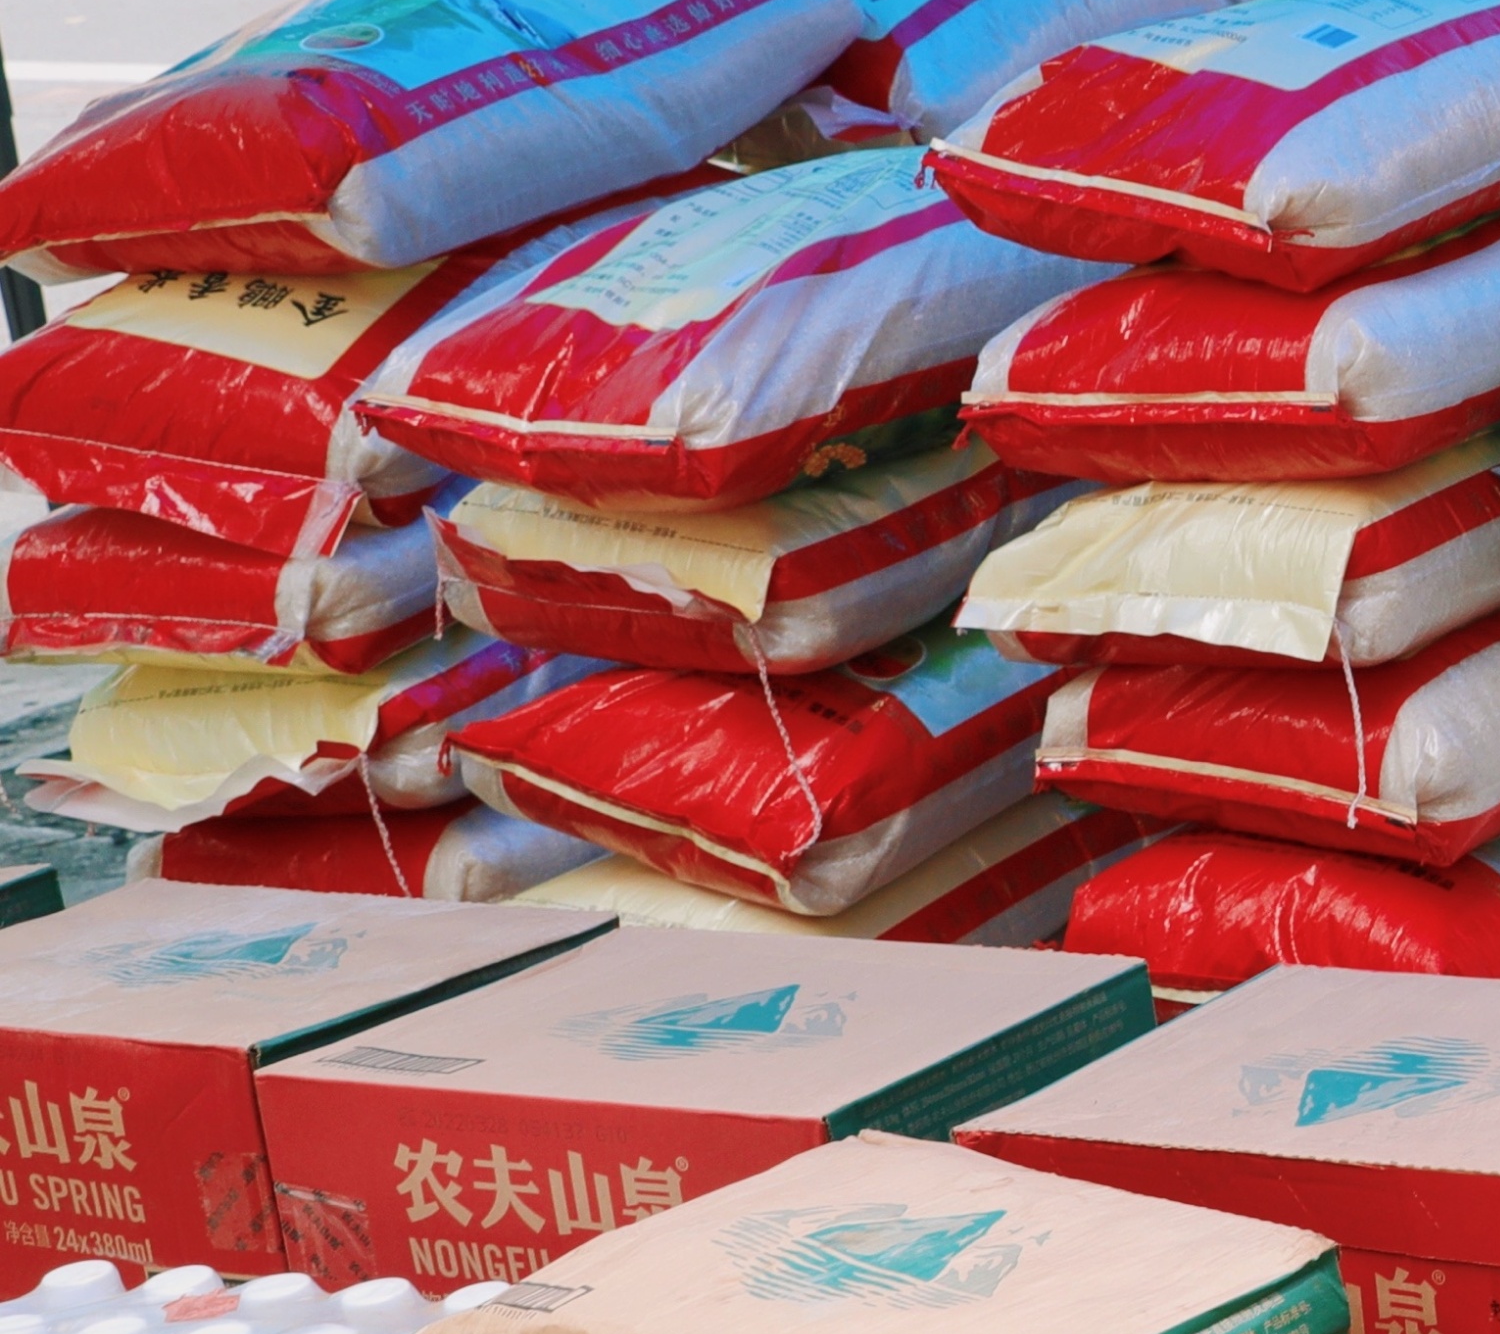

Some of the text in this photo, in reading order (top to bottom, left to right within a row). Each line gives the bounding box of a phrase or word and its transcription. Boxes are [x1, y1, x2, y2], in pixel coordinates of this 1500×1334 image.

[29, 1172, 146, 1224] SPRING
[394, 1137, 685, 1237] 农夫山泉
[4, 1220, 155, 1264] 净含量 24x380ml
